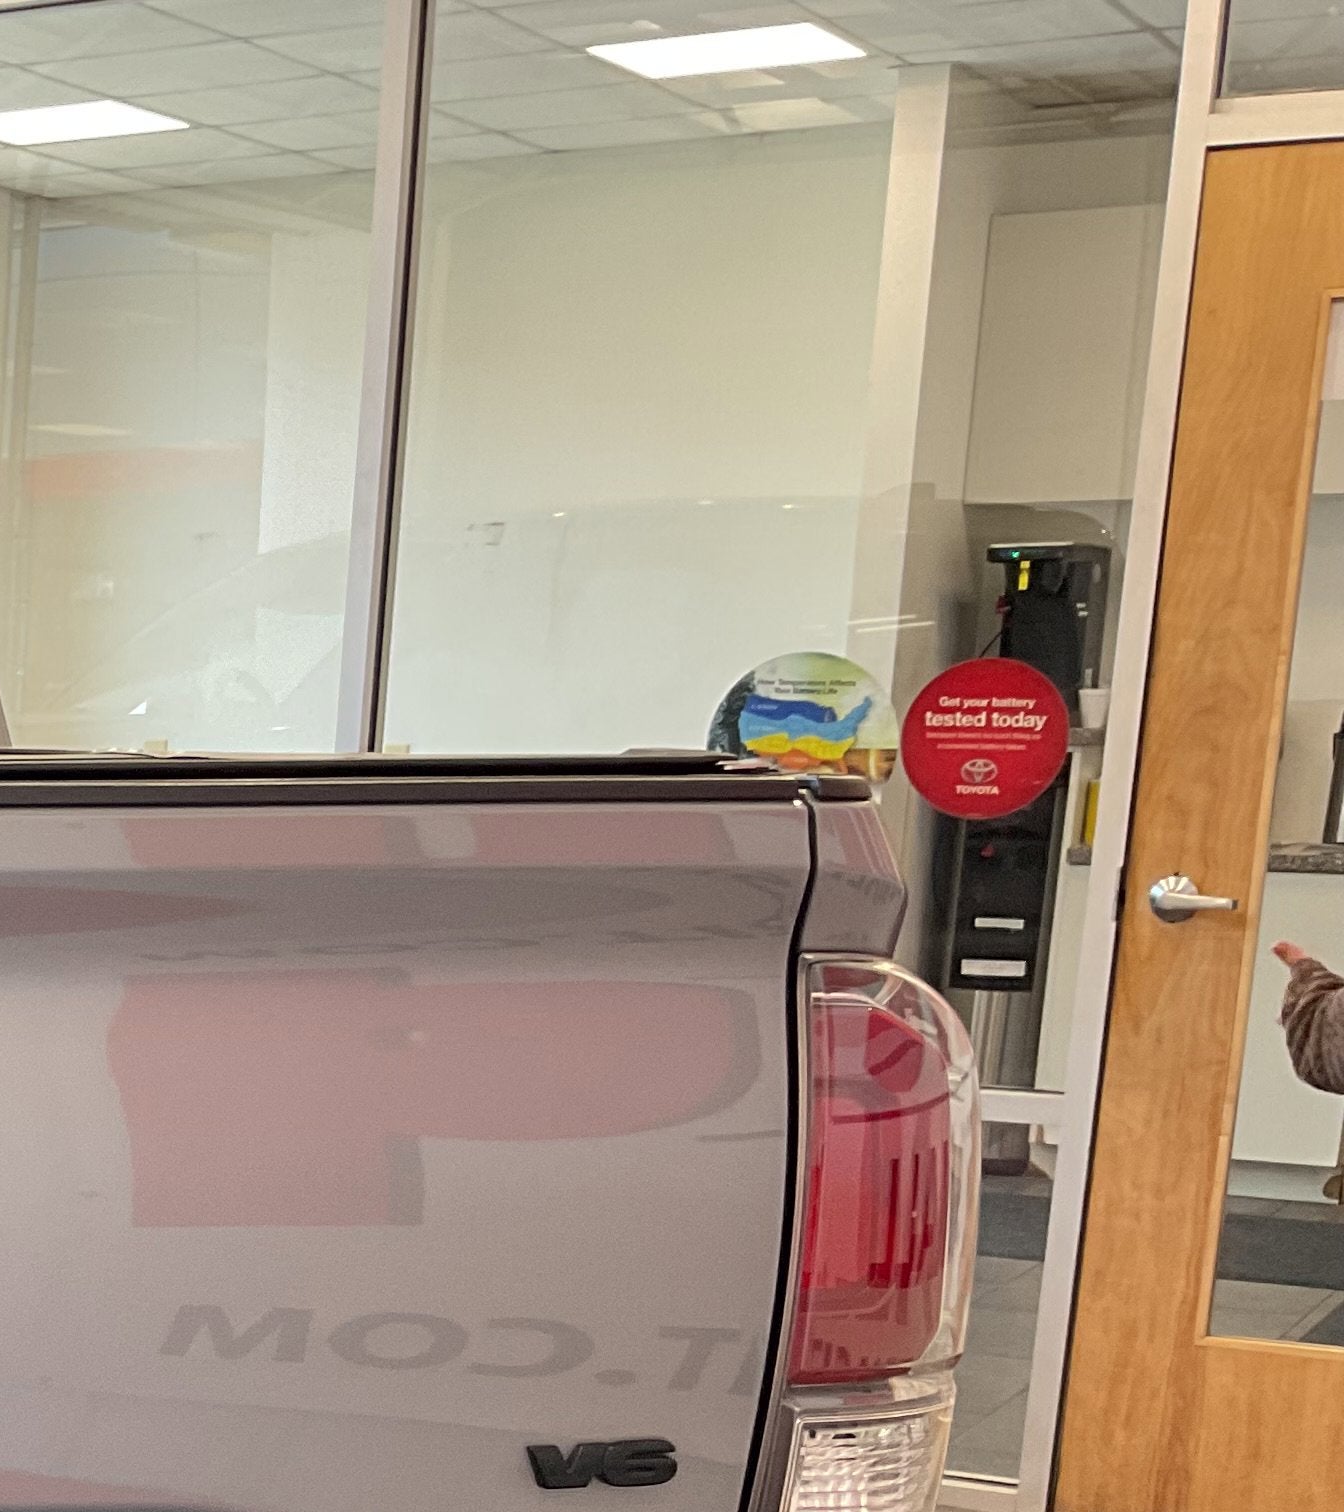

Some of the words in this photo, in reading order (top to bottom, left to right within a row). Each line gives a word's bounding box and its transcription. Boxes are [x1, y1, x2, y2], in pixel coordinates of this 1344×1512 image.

[939, 696, 961, 707] Get
[963, 699, 990, 709] your
[991, 697, 1036, 709] battery
[925, 711, 987, 727] tested
[991, 711, 1048, 731] today
[956, 785, 999, 795] TOYOTA
[526, 1438, 678, 1489] V6
